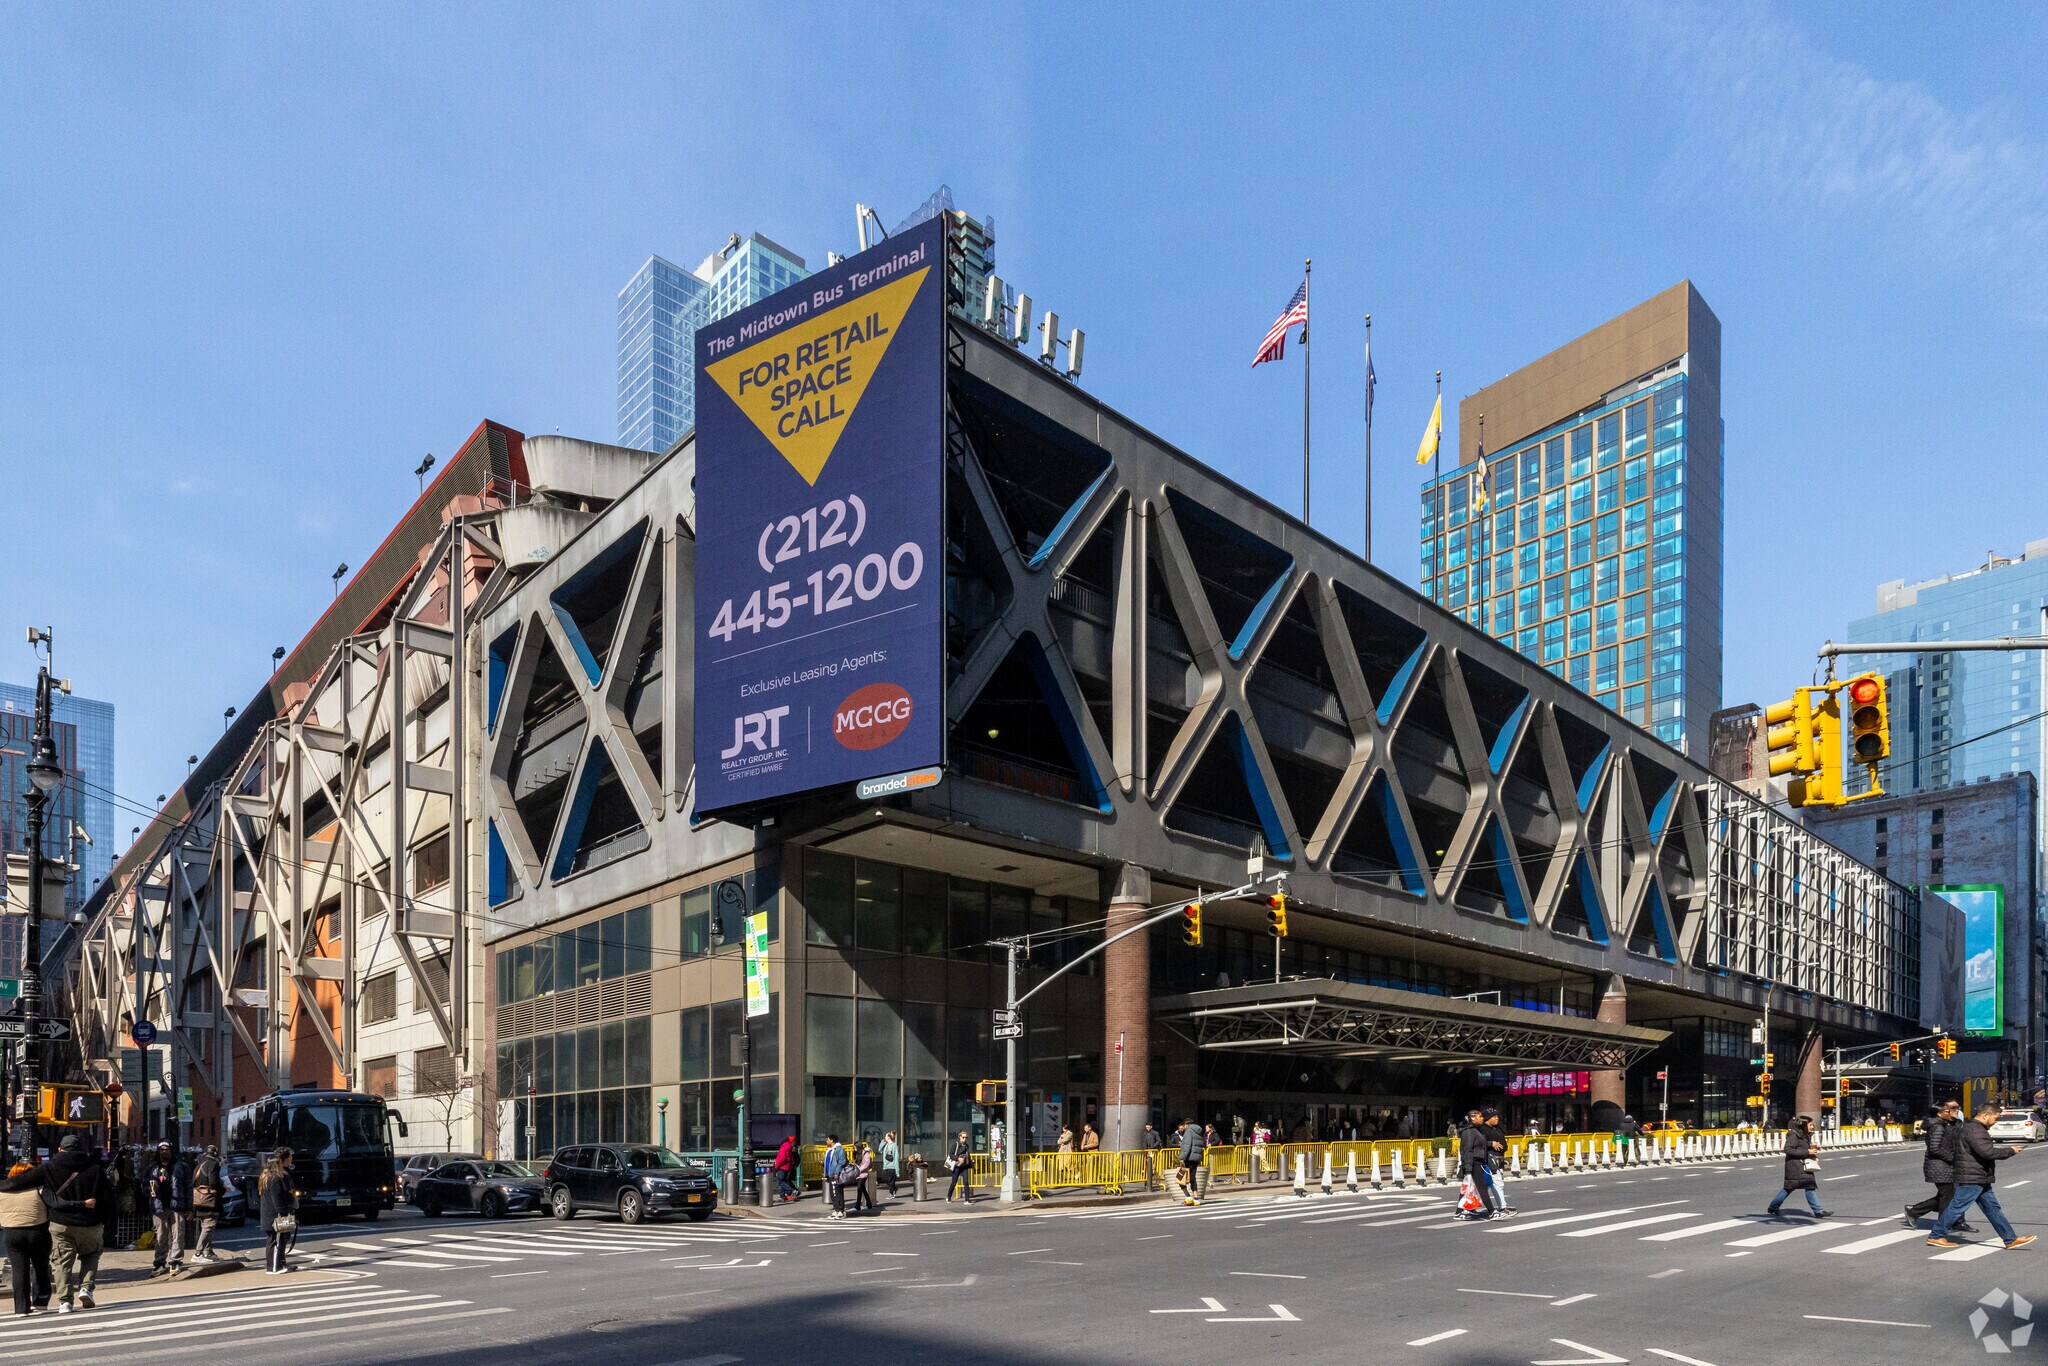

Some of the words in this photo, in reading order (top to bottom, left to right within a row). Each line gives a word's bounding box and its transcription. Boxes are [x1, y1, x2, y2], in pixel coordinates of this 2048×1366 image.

[707, 336, 735, 356] The
[740, 301, 808, 343] Midtown
[813, 284, 844, 309] Bus
[849, 242, 925, 291] Terminal
[738, 353, 790, 396] FOR
[796, 311, 889, 371] RETAIL
[770, 356, 852, 412] SPACE
[777, 394, 845, 438] CALL
[757, 493, 866, 574] (212)
[708, 541, 924, 642] 445-1200
[740, 675, 791, 698] Exclusive
[793, 663, 838, 684] Leasing
[840, 649, 887, 671] Agents:
[721, 705, 790, 760] JRT
[835, 696, 911, 734] MCCG
[721, 757, 748, 770] REALTY
[748, 752, 774, 764] GROUP,
[775, 748, 790, 758] INC.
[727, 767, 760, 781] CERTIFIED
[862, 772, 937, 795] brandedcities
[690, 1159, 706, 1167] Subway
